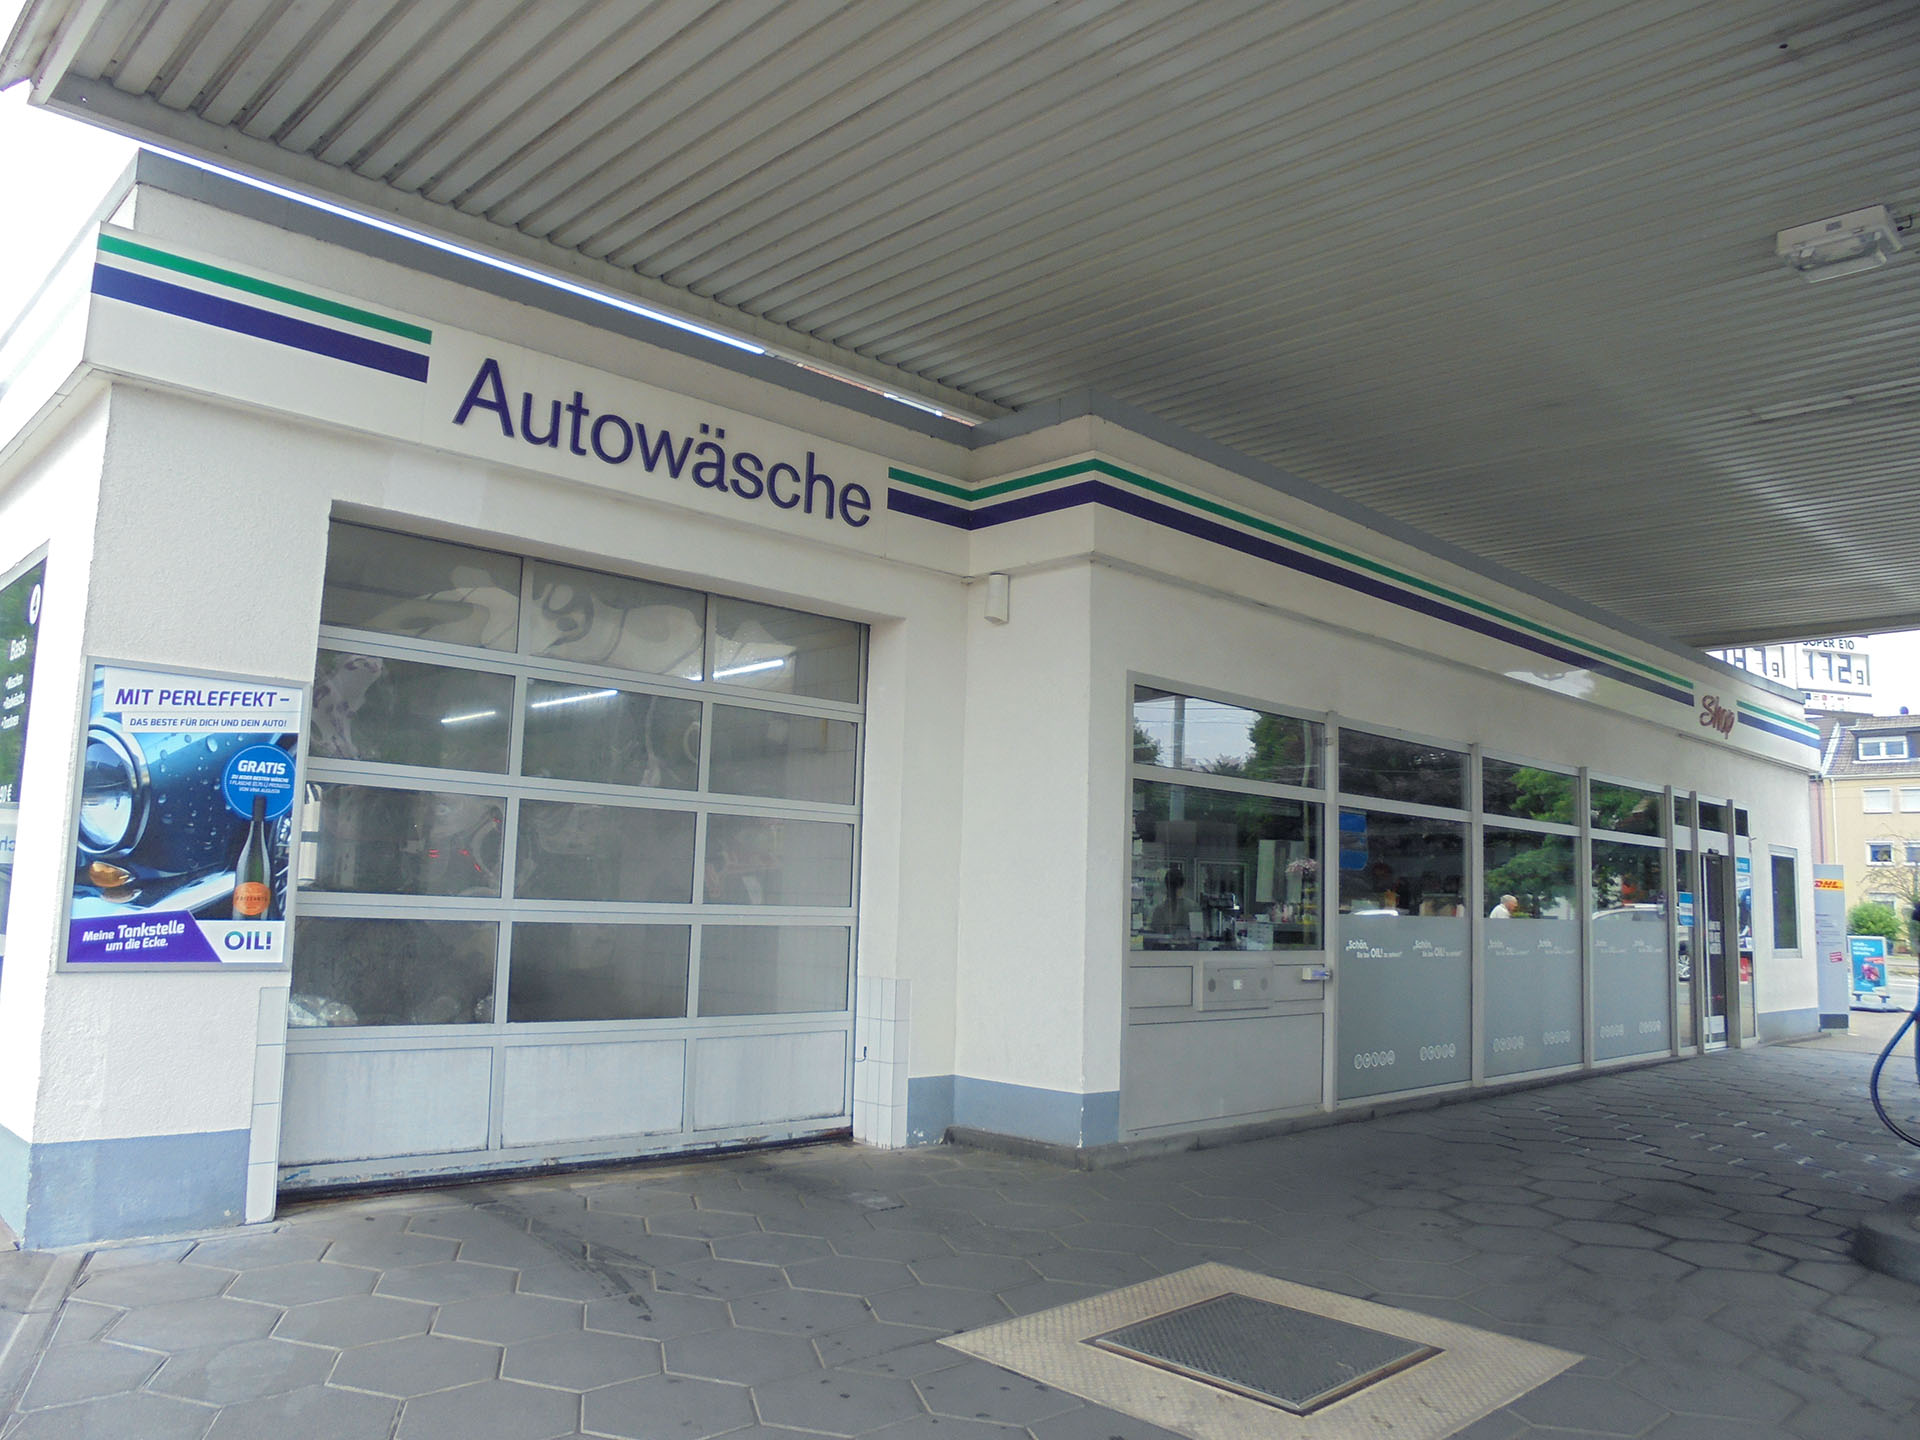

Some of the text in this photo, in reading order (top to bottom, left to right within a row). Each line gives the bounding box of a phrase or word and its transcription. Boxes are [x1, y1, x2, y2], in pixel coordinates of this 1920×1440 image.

[452, 357, 871, 528] Autowäsche
[9, 634, 28, 661] Basis
[1839, 640, 1855, 650] E10
[115, 688, 154, 706] MIT
[158, 689, 278, 708] PERLEFFEKT
[129, 716, 288, 728] DAS BESTE FÜR DICH UND DEIN AUTO!
[238, 759, 287, 775] GRATIS
[1814, 880, 1839, 889] DHL
[82, 919, 185, 943] Meine Tankstelle
[105, 935, 169, 952] um die Ecke.
[224, 930, 273, 951] OIL!
